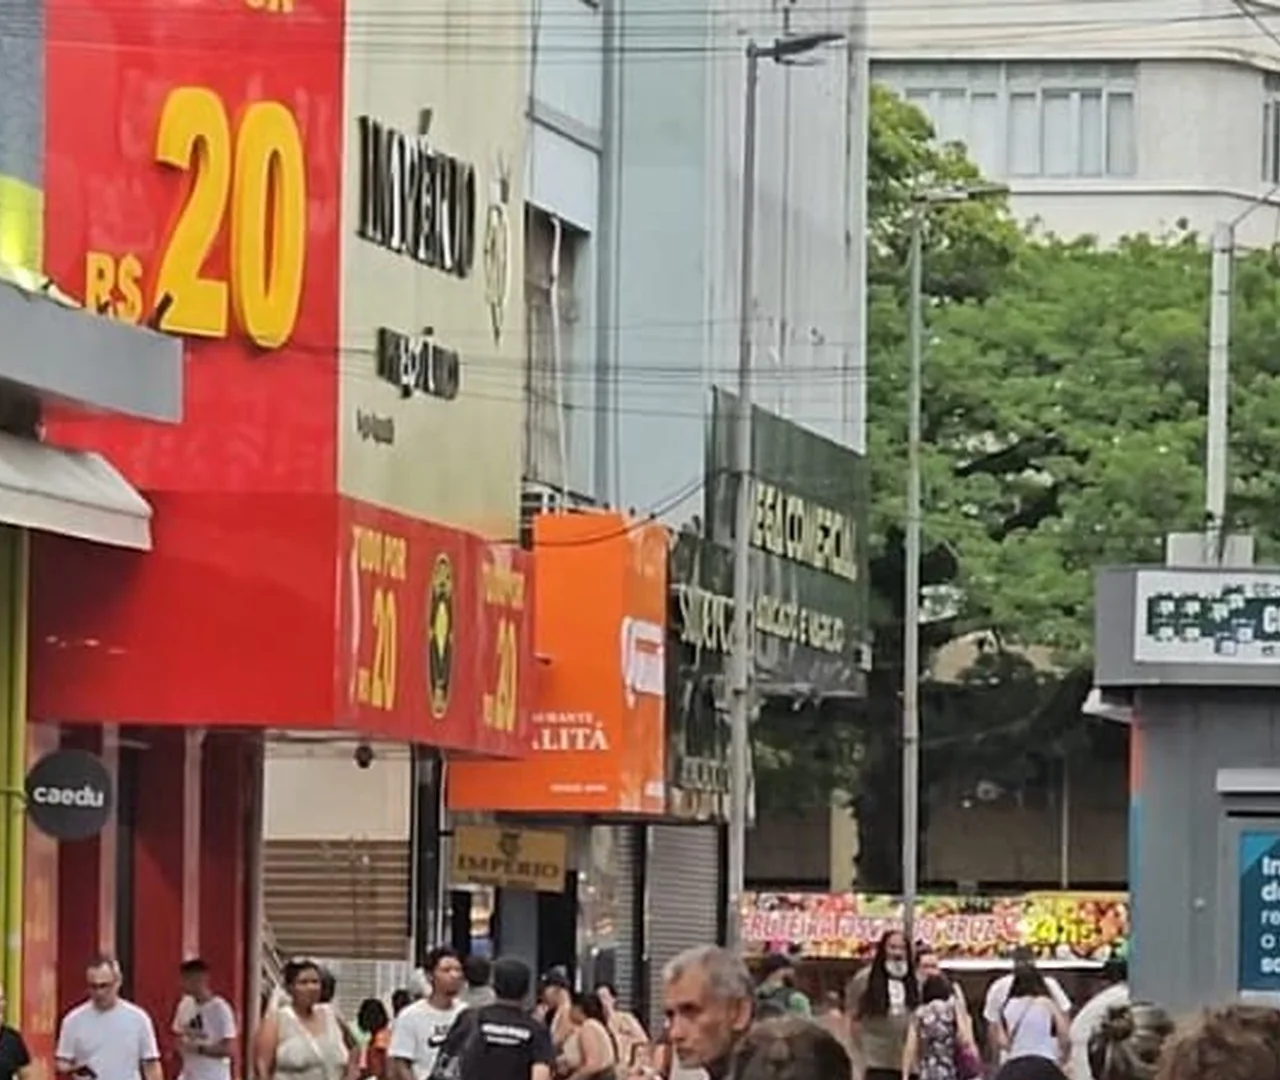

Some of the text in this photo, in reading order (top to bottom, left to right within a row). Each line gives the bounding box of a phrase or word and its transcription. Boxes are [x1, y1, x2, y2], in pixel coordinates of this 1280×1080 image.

[86, 86, 306, 349] R$ 20
[531, 721, 610, 750] LITÁ
[33, 785, 105, 808] caedu
[1260, 934, 1274, 950] o
